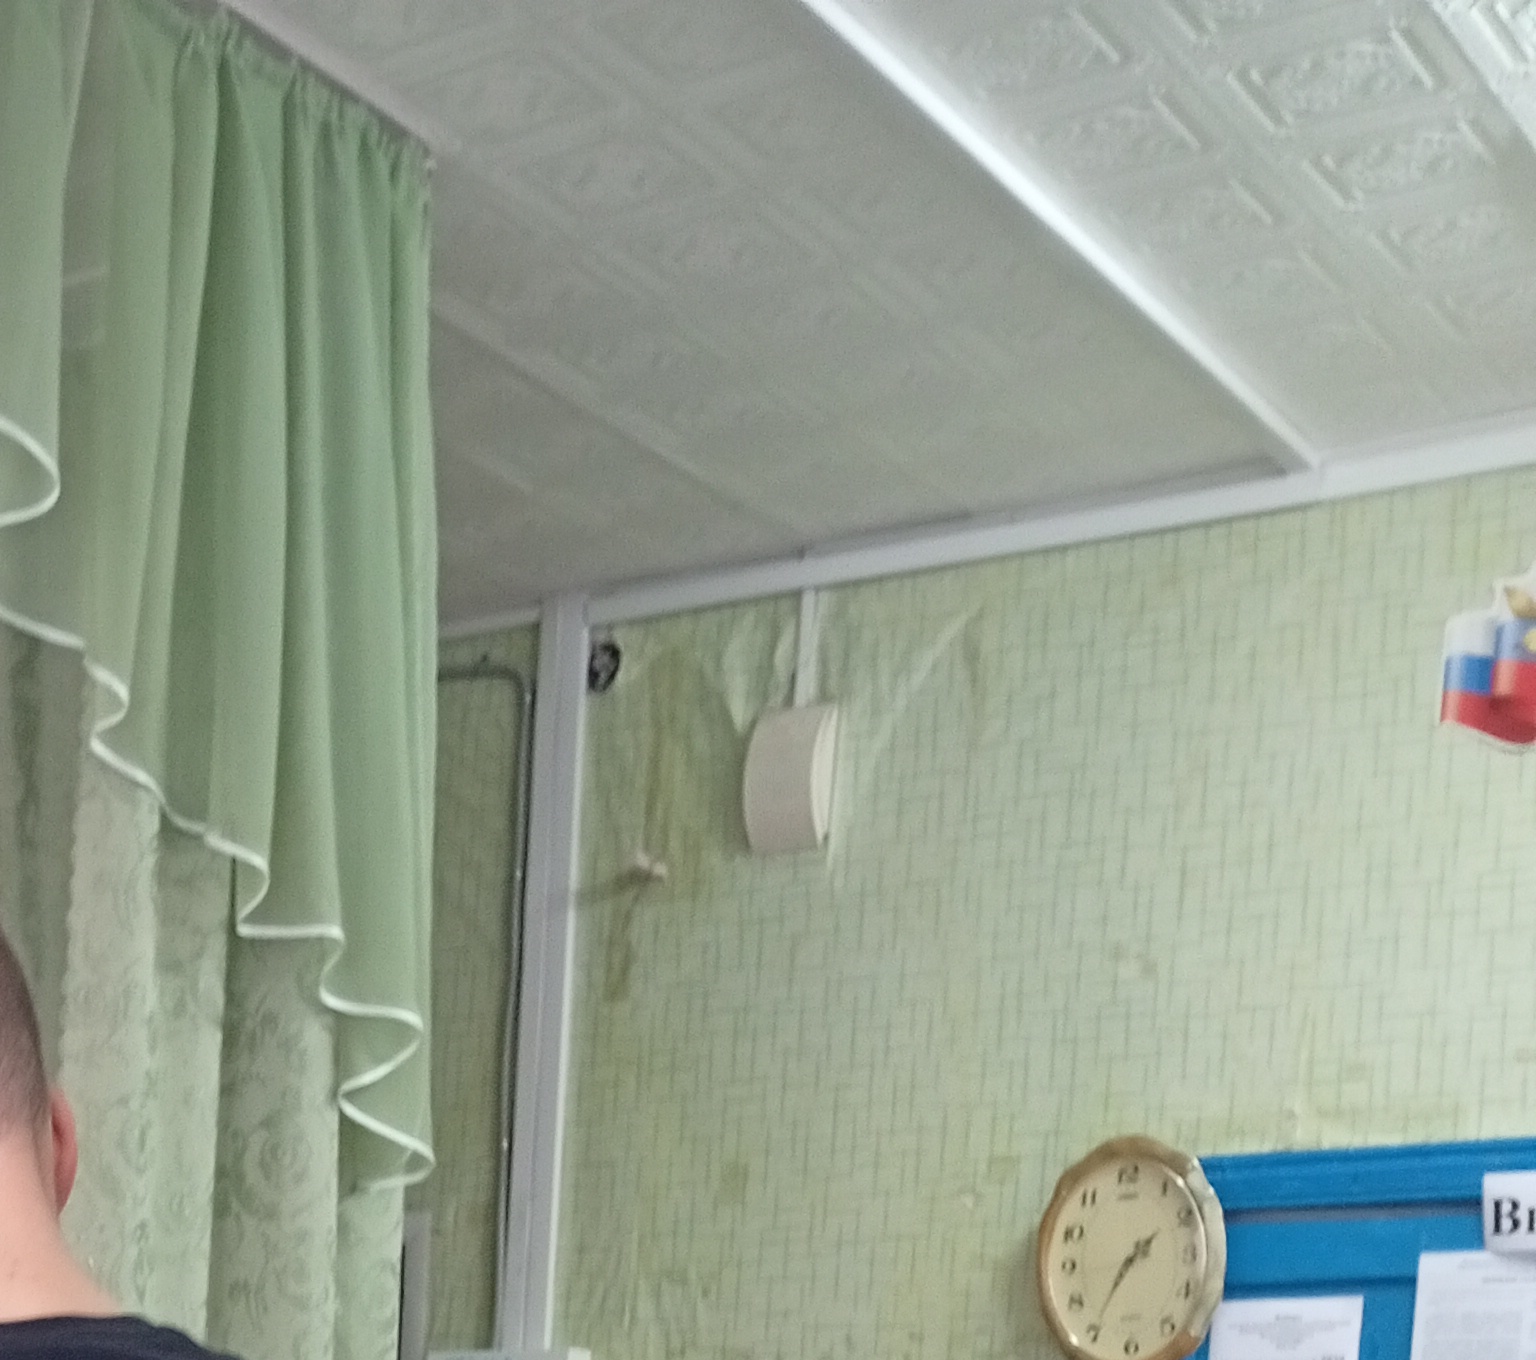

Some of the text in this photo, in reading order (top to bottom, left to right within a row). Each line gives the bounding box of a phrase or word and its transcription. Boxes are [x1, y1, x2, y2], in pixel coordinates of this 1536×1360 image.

[1118, 1164, 1139, 1184] 12
[1081, 1188, 1097, 1207] 11
[1065, 1224, 1084, 1242] 10
